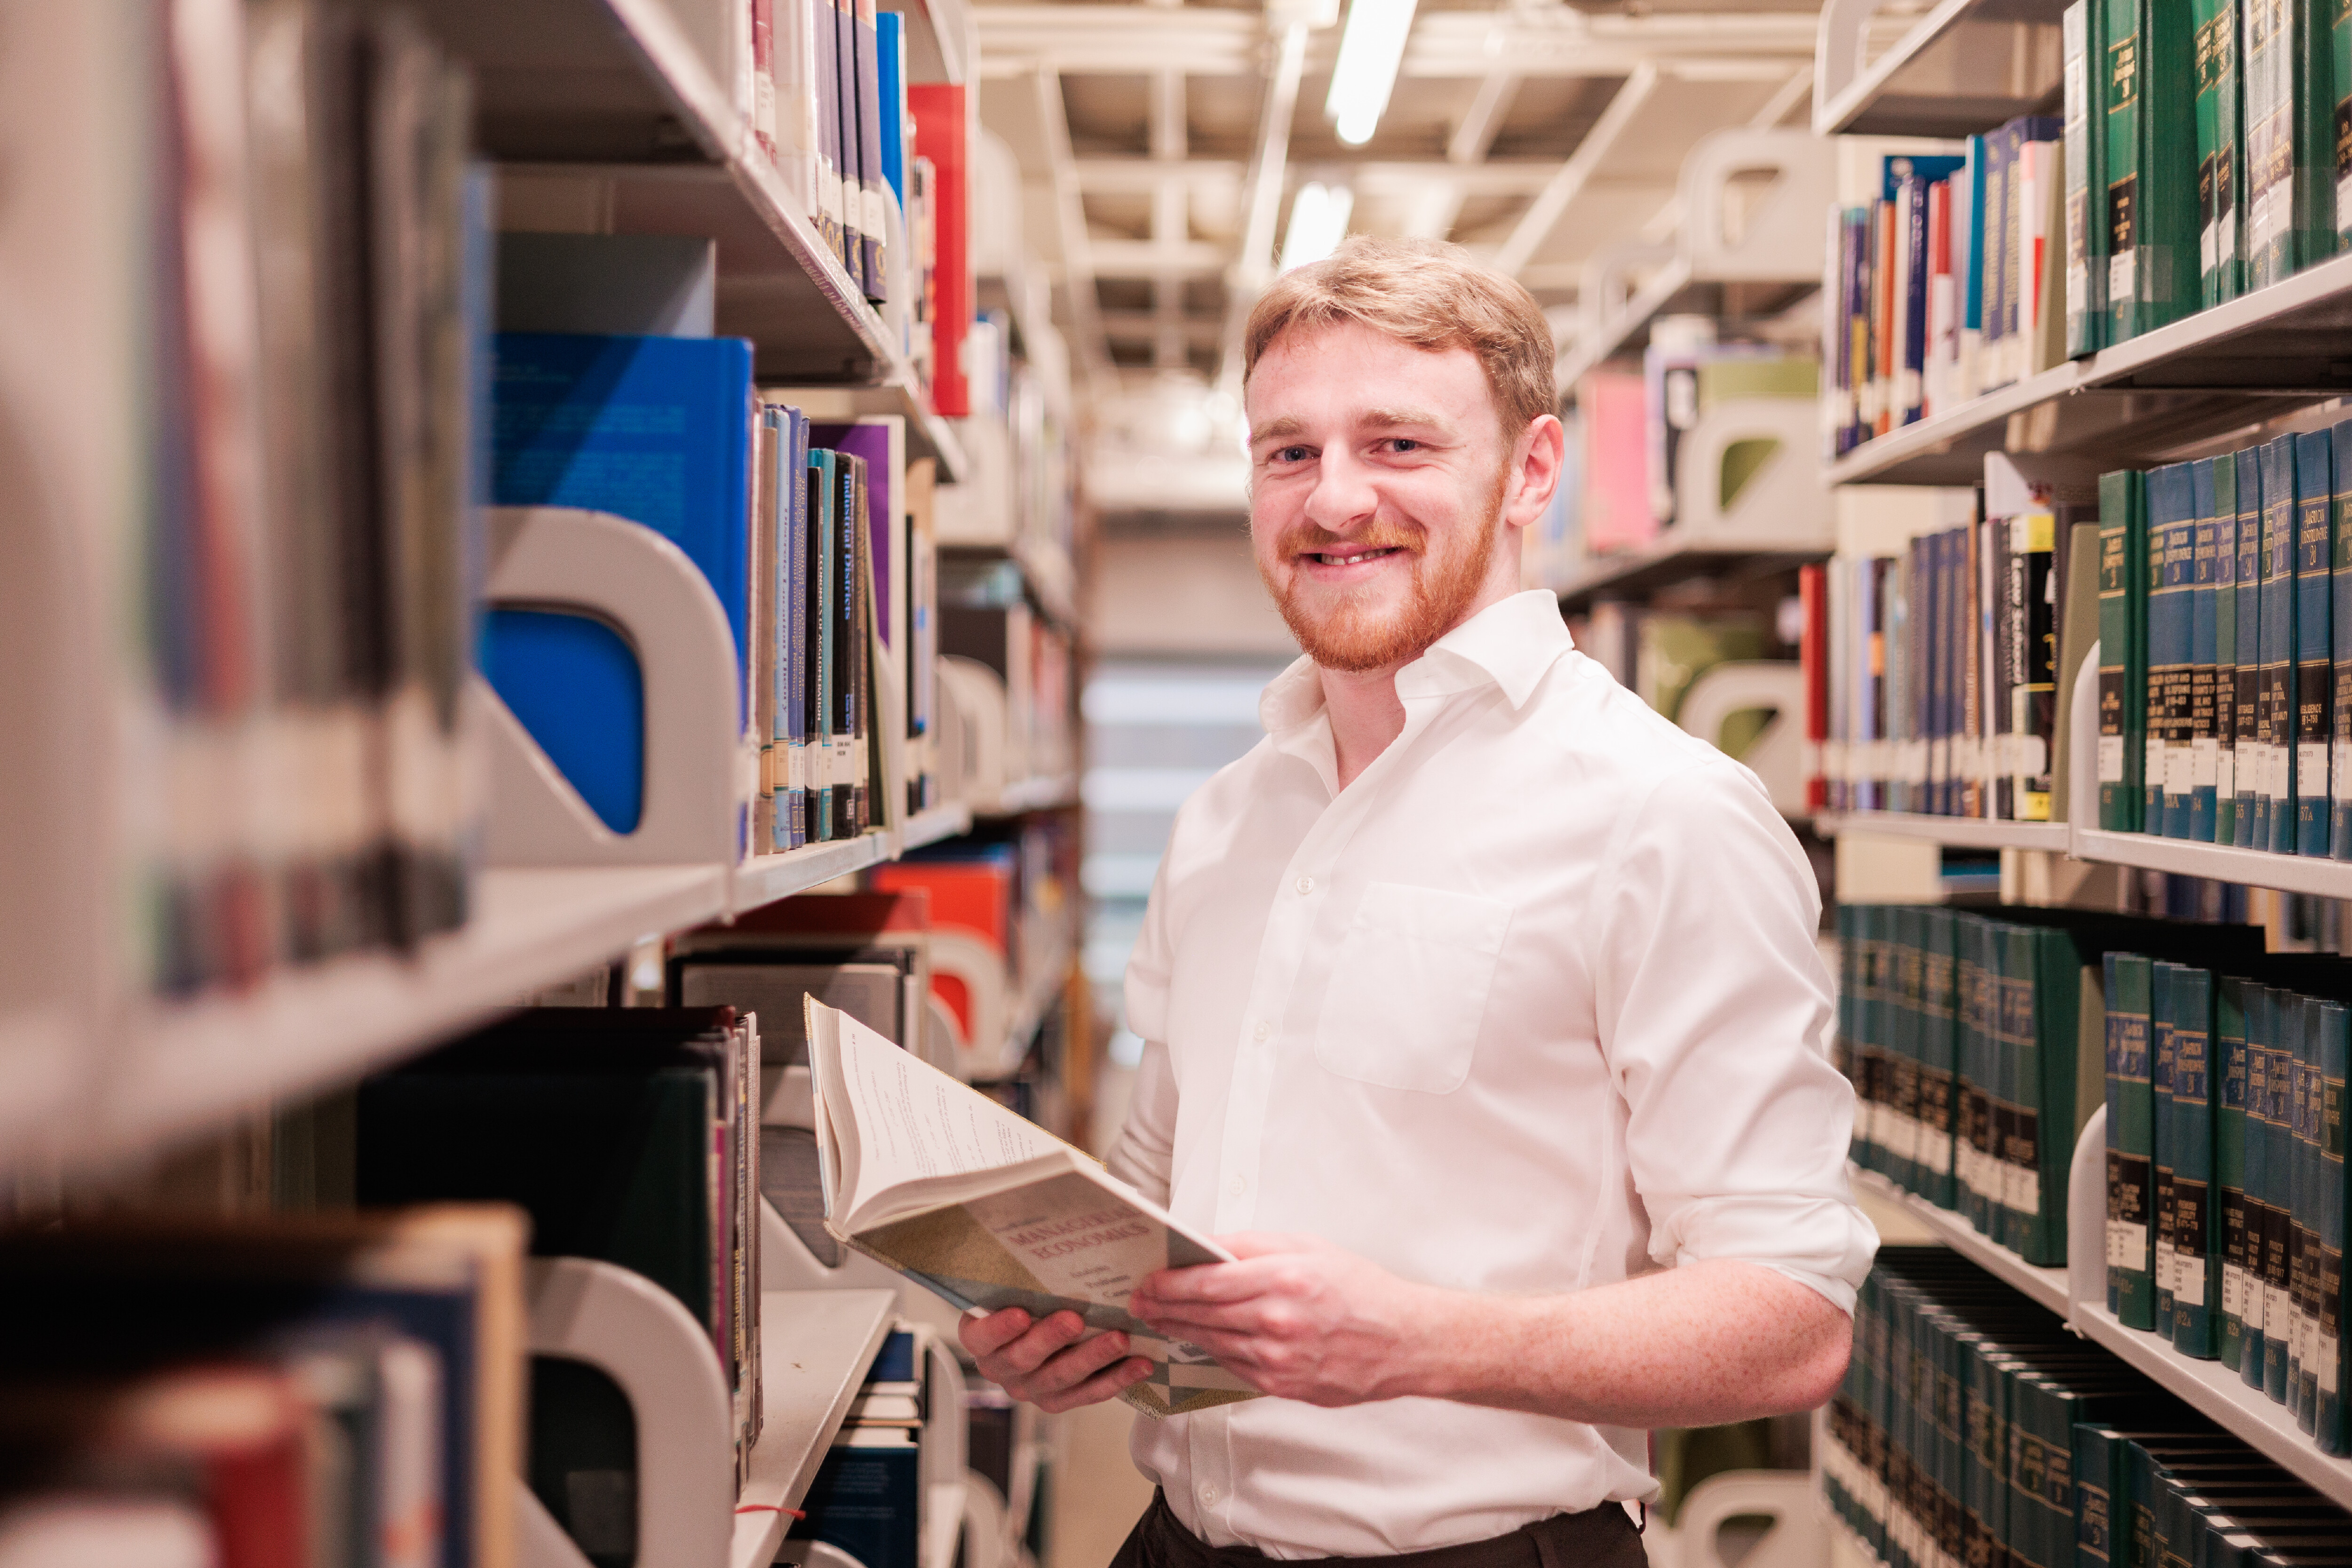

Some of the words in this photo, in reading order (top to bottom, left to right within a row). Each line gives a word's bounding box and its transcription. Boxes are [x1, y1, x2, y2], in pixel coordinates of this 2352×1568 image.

[2303, 509, 2325, 528] AMERICAN
[2299, 526, 2328, 549] JURISPRUDENCE
[2310, 545, 2317, 565] 2d
[2300, 704, 2322, 714] NEGLIGENCE
[2300, 806, 2313, 821] 57A
[1008, 1207, 1143, 1246] MANAGERIAL
[1030, 1222, 1150, 1260] ECONOMICS
